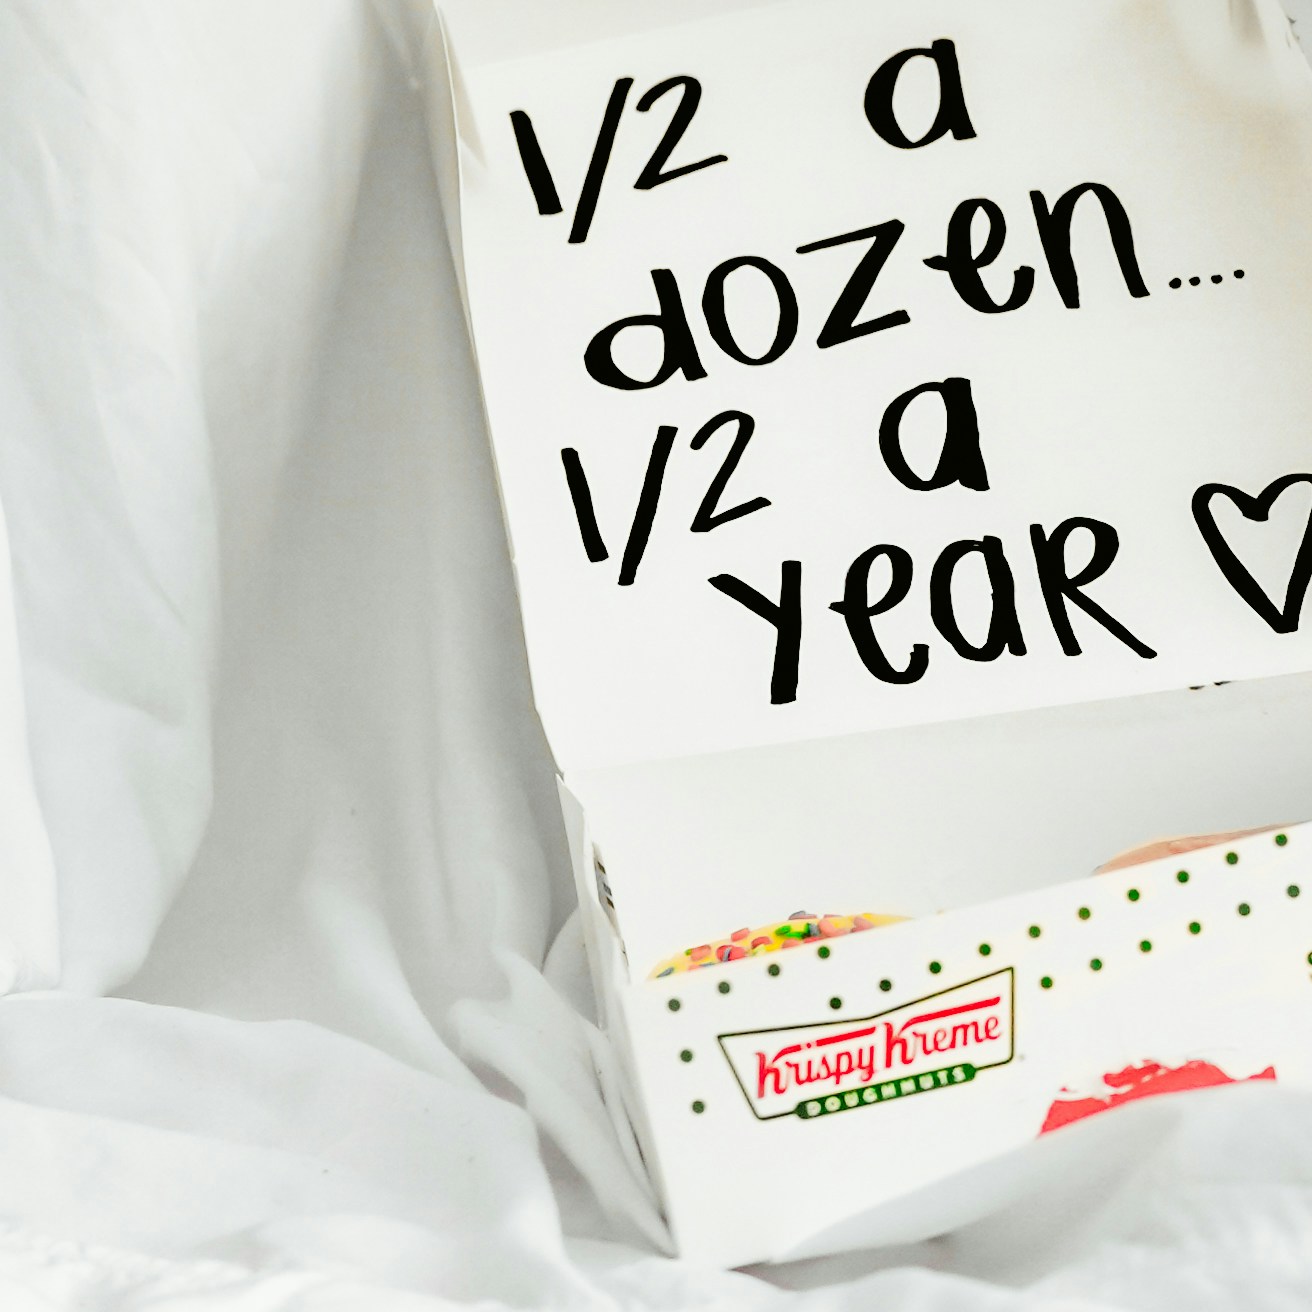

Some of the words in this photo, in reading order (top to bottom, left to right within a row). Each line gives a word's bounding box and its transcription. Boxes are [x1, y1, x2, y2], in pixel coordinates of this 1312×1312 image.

[509, 75, 729, 244] 1/2
[863, 38, 978, 150] a
[560, 409, 772, 586] 1/2
[878, 377, 991, 492] a
[755, 1025, 878, 1099] Krispy
[883, 995, 1002, 1069] Kreme
[805, 1066, 968, 1118] DOUGHNUTS
